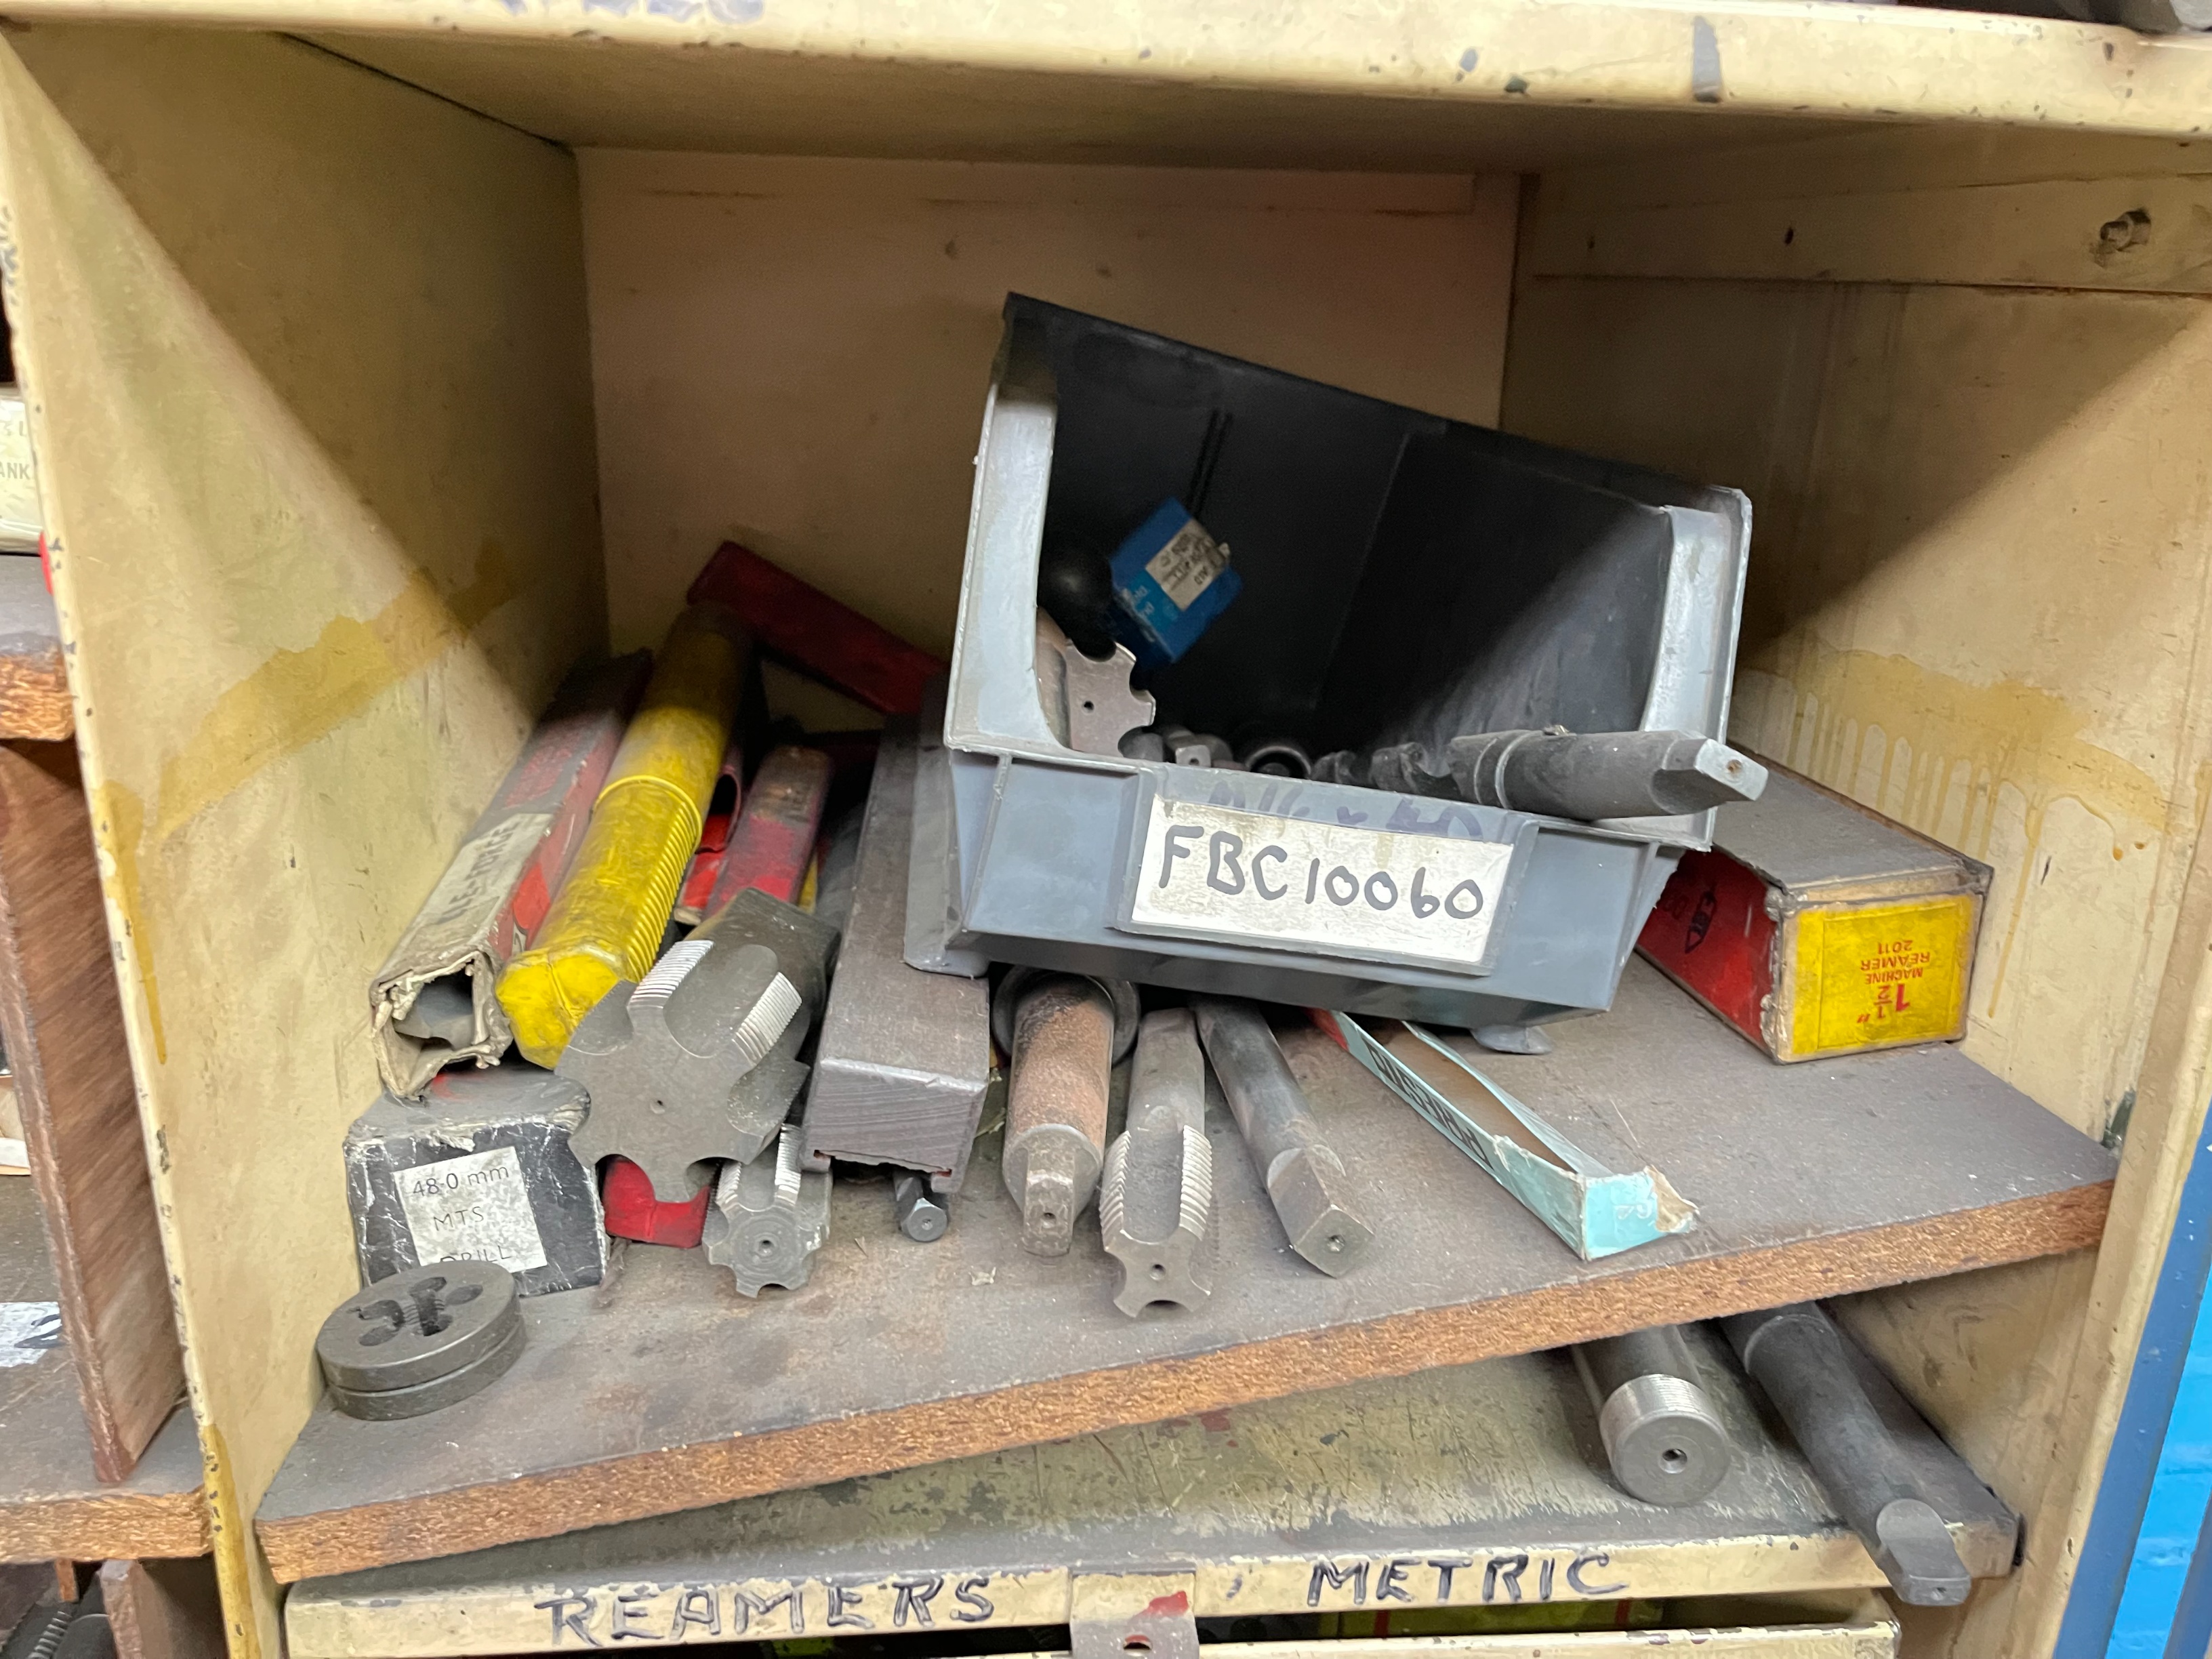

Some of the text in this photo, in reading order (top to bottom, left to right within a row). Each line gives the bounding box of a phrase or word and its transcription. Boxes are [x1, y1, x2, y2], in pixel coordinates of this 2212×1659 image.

[1159, 824, 1484, 920] FBC10060
[1877, 940, 1913, 955] 2011
[1860, 951, 1931, 971] REAMER
[1865, 968, 1923, 985] MACHINE
[1361, 1036, 1495, 1172] PRESTO
[467, 1166, 509, 1186] mm
[433, 1206, 485, 1231] MTS
[534, 1551, 1629, 1648] REAMERS METRIC
